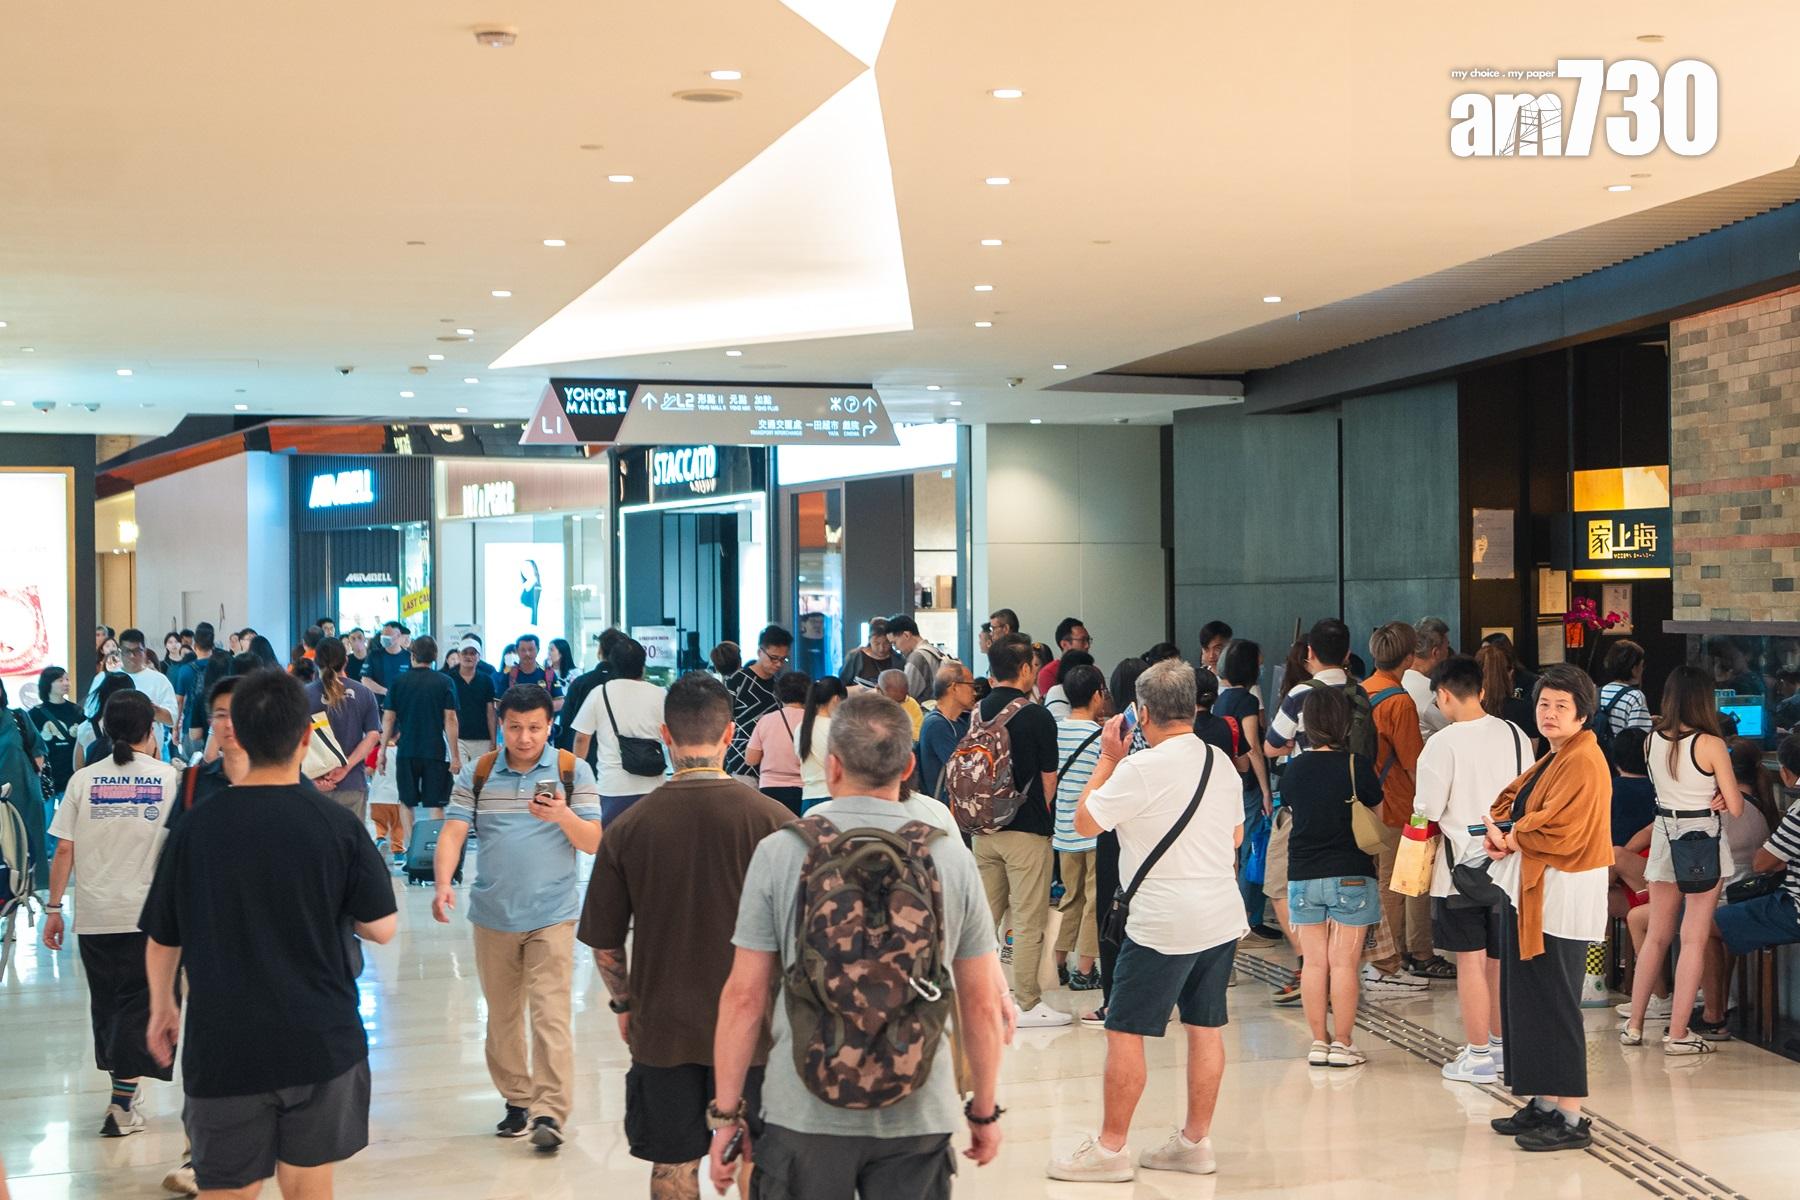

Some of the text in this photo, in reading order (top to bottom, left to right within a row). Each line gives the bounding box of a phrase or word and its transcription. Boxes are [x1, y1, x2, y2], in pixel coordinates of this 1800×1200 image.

[676, 393, 695, 408] L2
[653, 445, 716, 486] STACCATO
[345, 572, 392, 582] MIRABELL
[92, 776, 162, 785] TRAIN MAN
